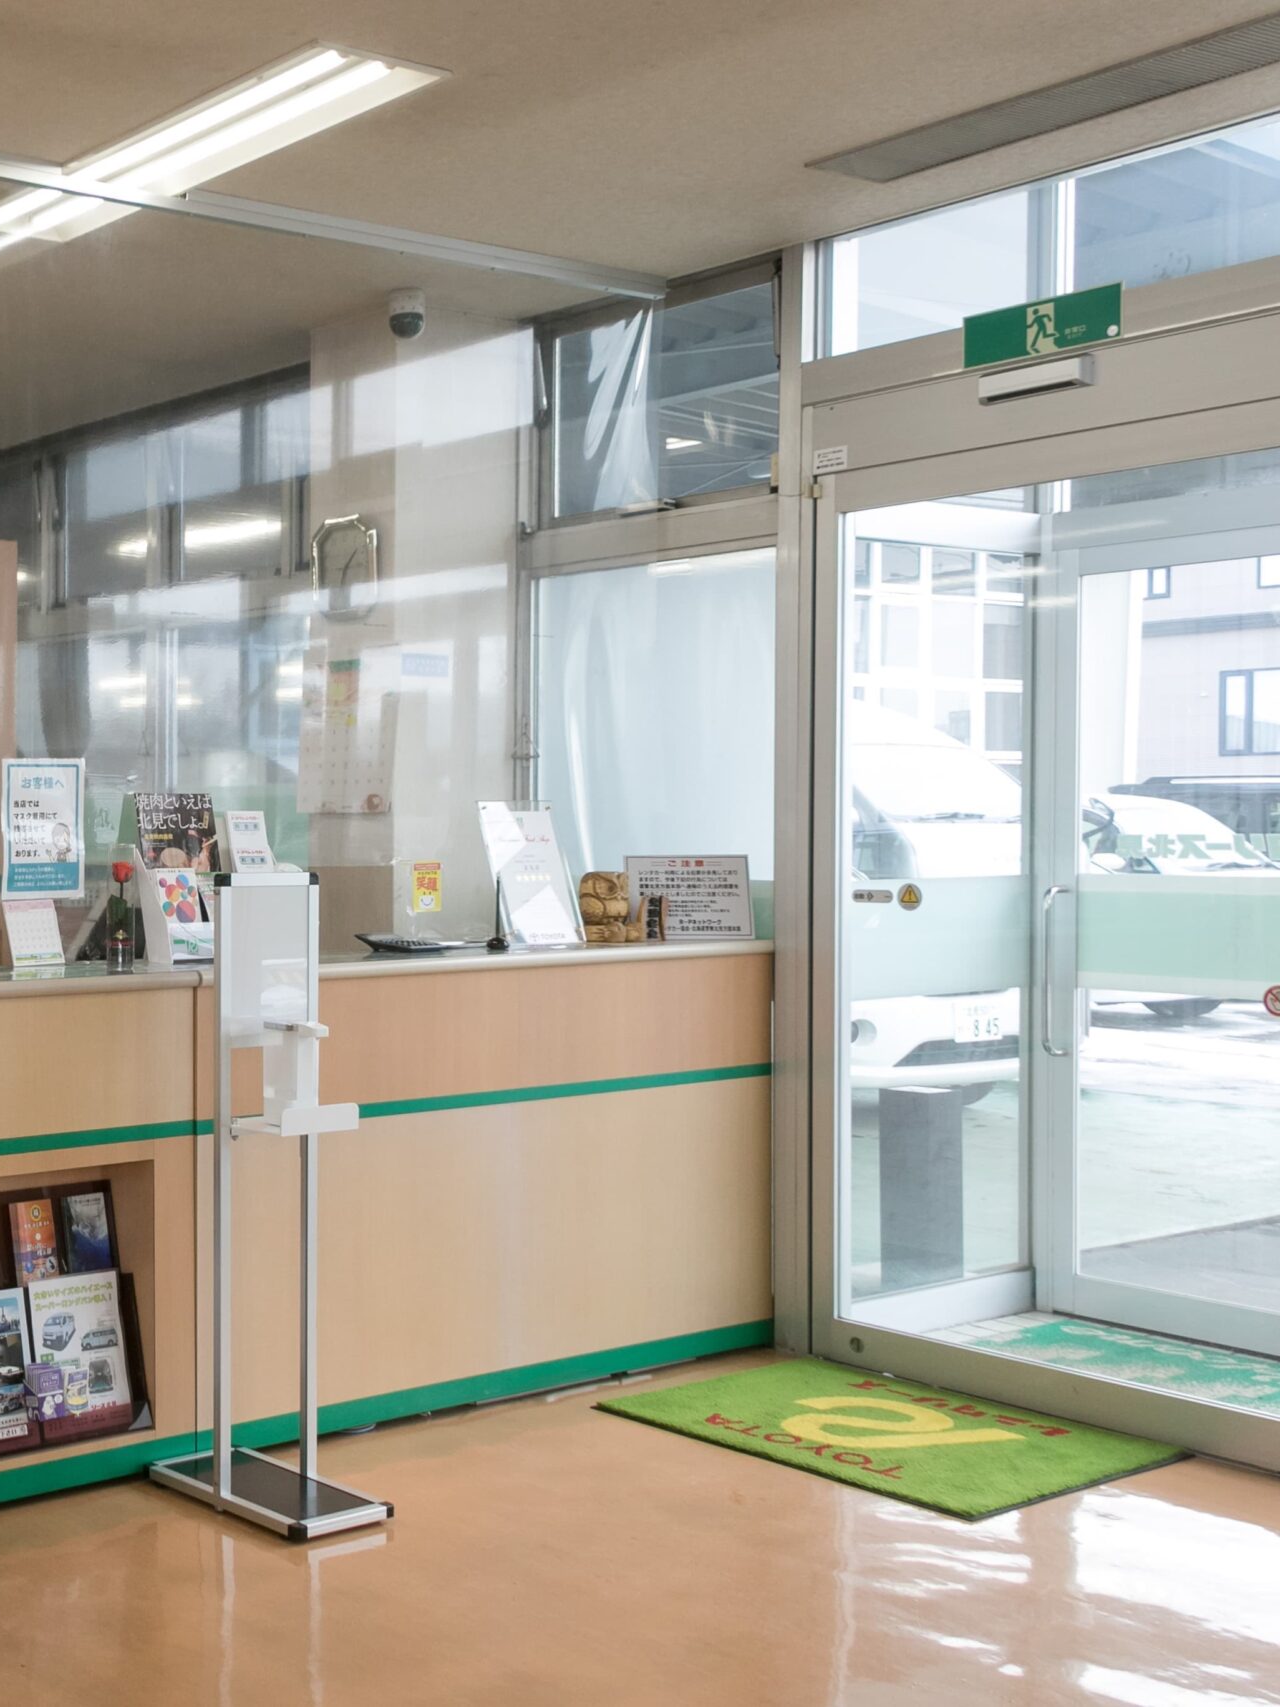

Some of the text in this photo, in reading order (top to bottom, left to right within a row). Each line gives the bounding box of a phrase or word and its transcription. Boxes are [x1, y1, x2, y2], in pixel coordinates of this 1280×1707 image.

[20, 776, 65, 790] お客様へ
[13, 800, 40, 808] 当店では
[703, 1412, 904, 1481] TOYOTA
